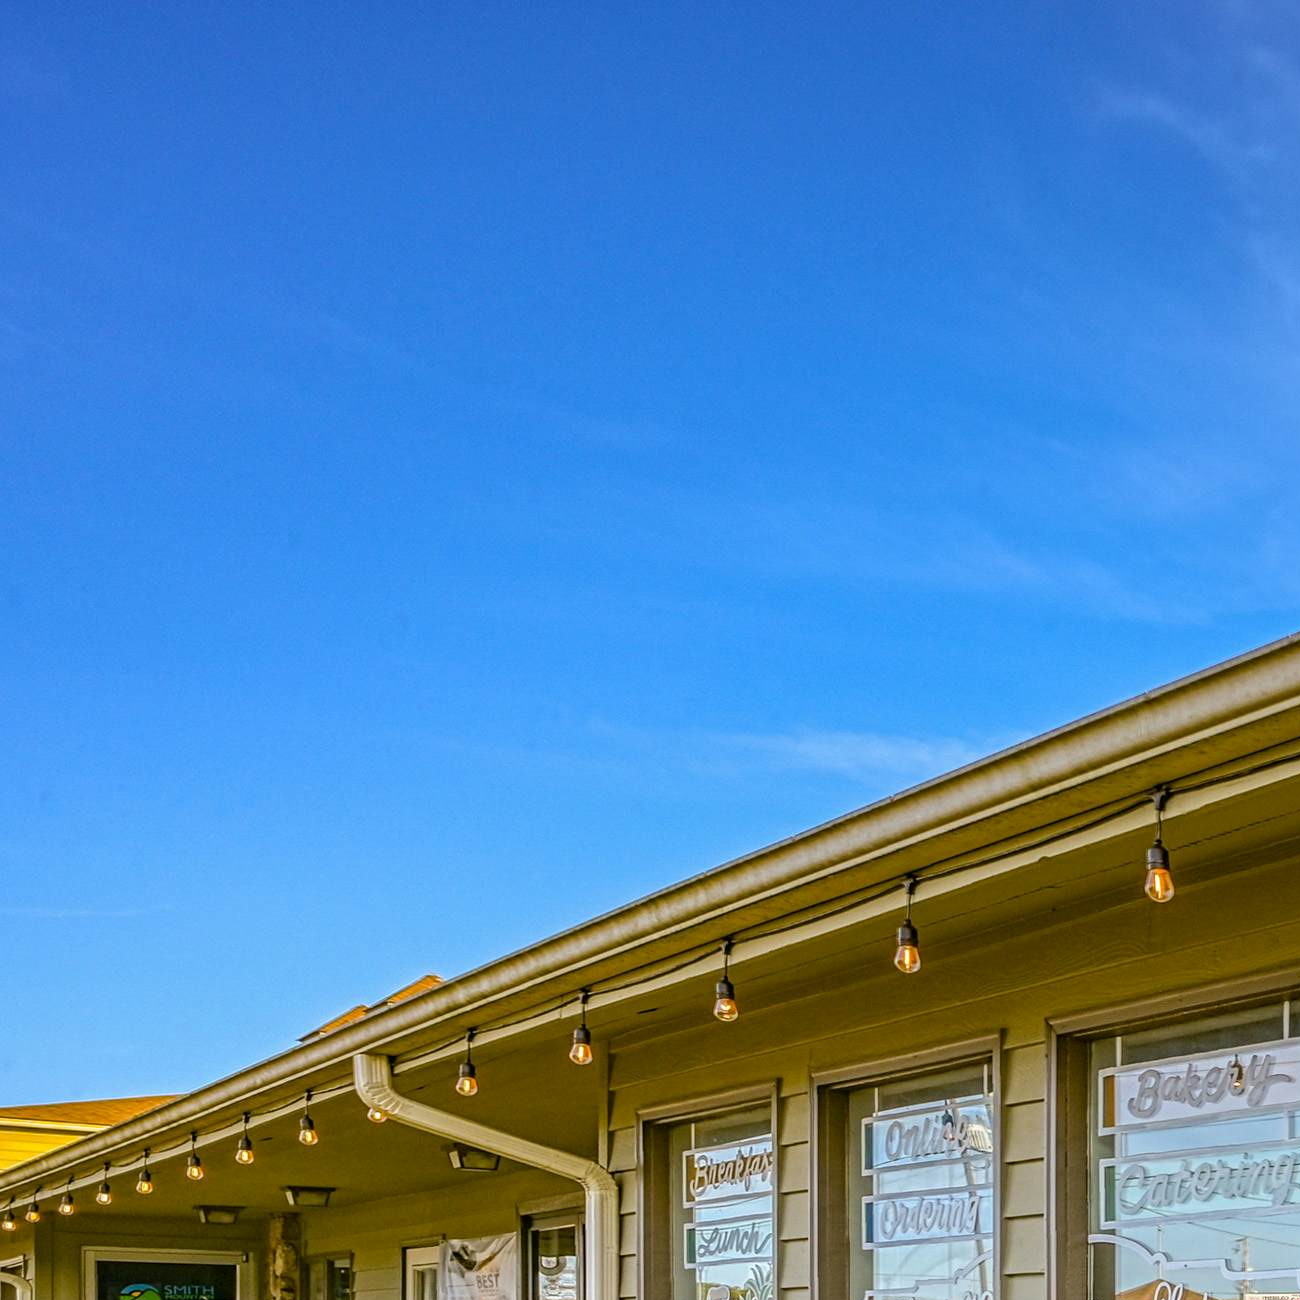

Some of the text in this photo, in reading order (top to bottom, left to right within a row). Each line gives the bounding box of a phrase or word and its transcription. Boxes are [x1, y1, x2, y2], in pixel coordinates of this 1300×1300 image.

[1128, 1054, 1296, 1119] Bakery
[690, 1147, 774, 1197] Breakfas
[880, 1194, 979, 1239] Ordering
[698, 1222, 772, 1258] Lunch
[164, 1285, 215, 1295] SMITH
[476, 1273, 500, 1289] BEST
